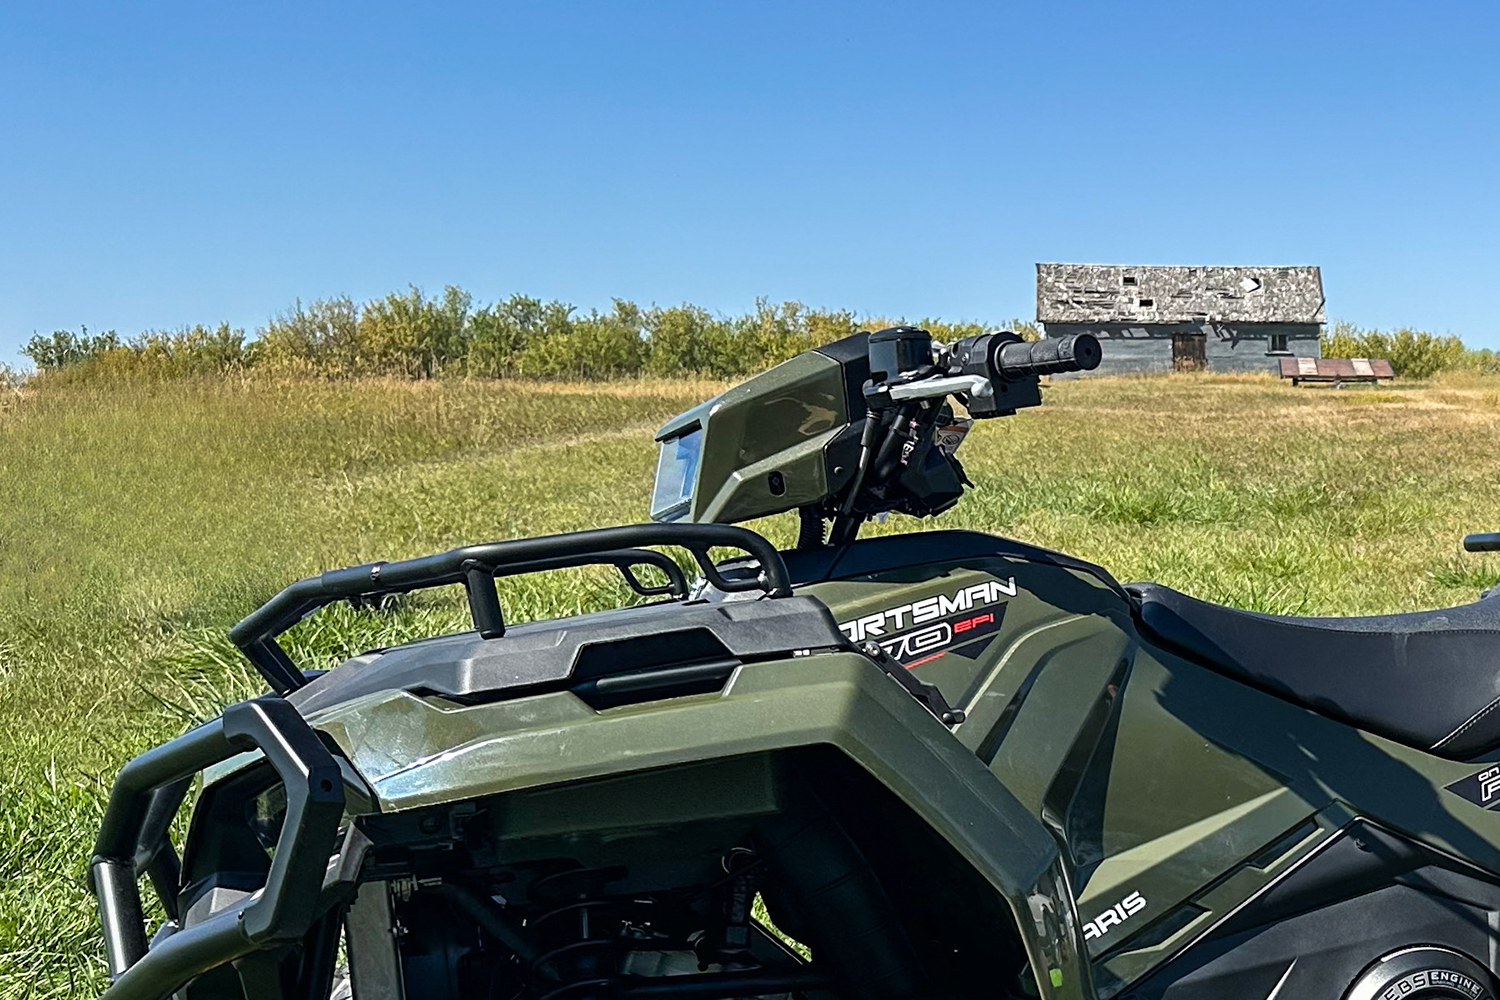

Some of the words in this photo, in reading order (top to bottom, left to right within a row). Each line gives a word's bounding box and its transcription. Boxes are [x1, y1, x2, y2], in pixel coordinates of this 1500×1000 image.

[838, 576, 1017, 643] ORTSMAN
[879, 622, 951, 661] 70
[953, 612, 995, 635] EPI
[1478, 767, 1499, 782] ON
[1082, 890, 1147, 940] ARIS
[1430, 971, 1480, 995] ENGINE
